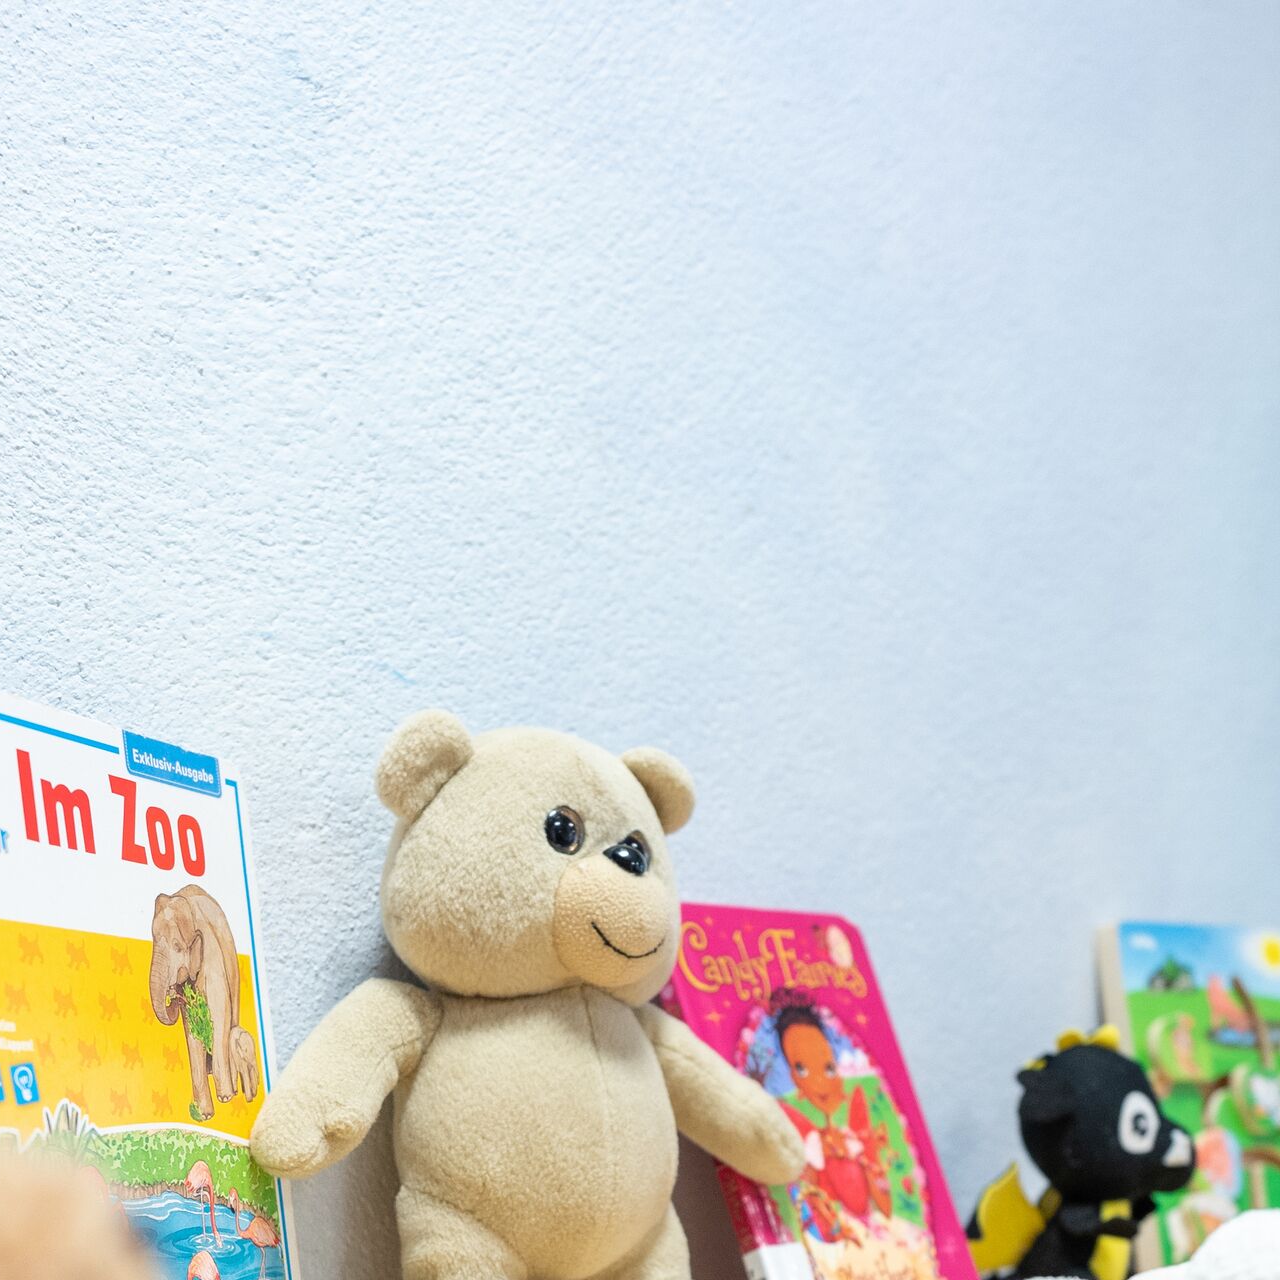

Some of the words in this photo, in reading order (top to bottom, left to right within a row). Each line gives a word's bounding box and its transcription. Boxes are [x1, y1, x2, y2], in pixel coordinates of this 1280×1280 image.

[131, 747, 215, 784] Exklusiv-Ausgabe
[16, 748, 97, 854] Im
[108, 774, 206, 877] Zoo
[677, 921, 772, 1006] Candy
